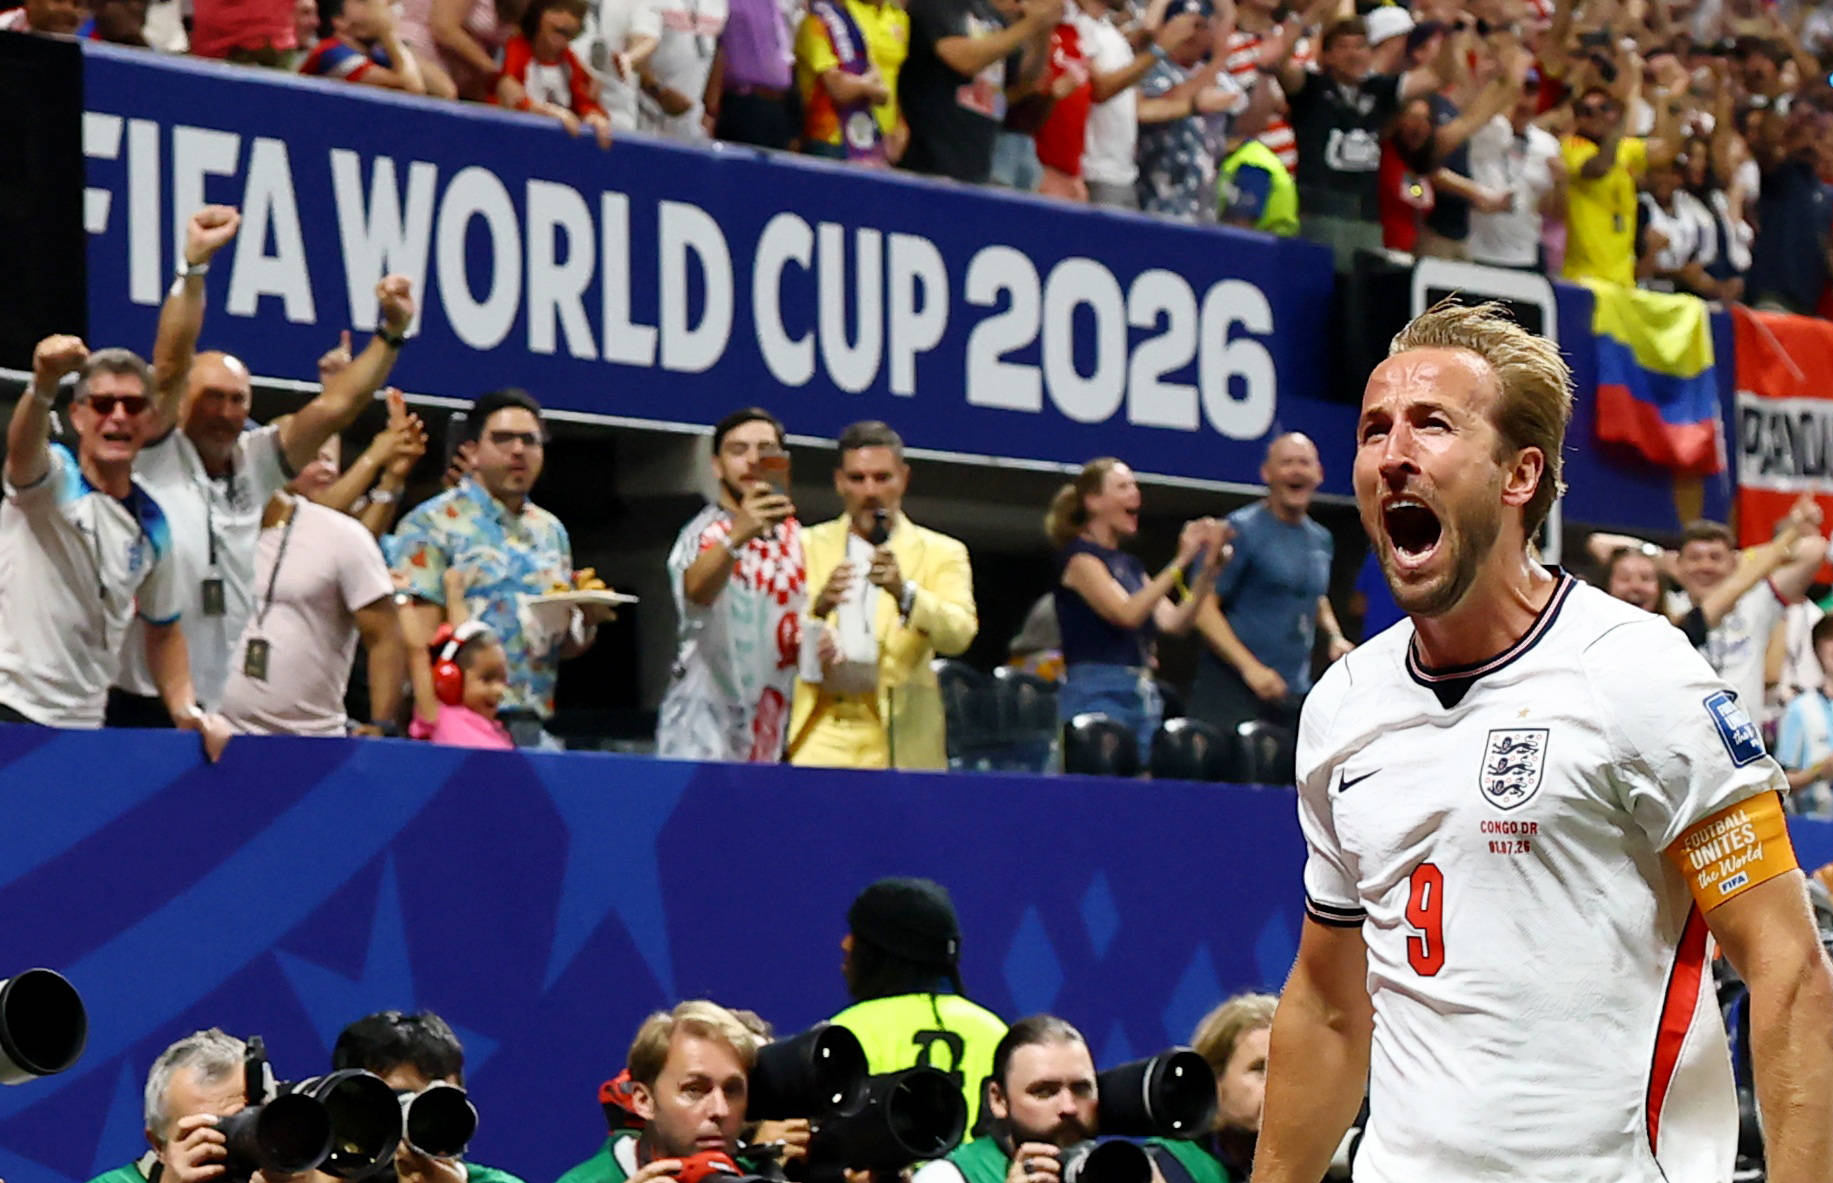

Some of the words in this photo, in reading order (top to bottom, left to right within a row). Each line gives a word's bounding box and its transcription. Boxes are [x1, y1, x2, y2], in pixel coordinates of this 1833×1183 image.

[83, 112, 316, 324] FIFA
[330, 149, 733, 373] WORLD
[753, 212, 949, 396] CUP
[966, 245, 1277, 440] 2026
[1480, 820, 1518, 835] CONGO
[1520, 821, 1538, 836] DR
[1488, 840, 1531, 855] 01.07.26
[1684, 809, 1752, 851] FOOTBALL
[1689, 823, 1756, 870] UNITES
[1698, 869, 1719, 889] the
[1719, 841, 1763, 877] World
[1721, 874, 1747, 892] FIFA
[1405, 862, 1446, 977] 9
